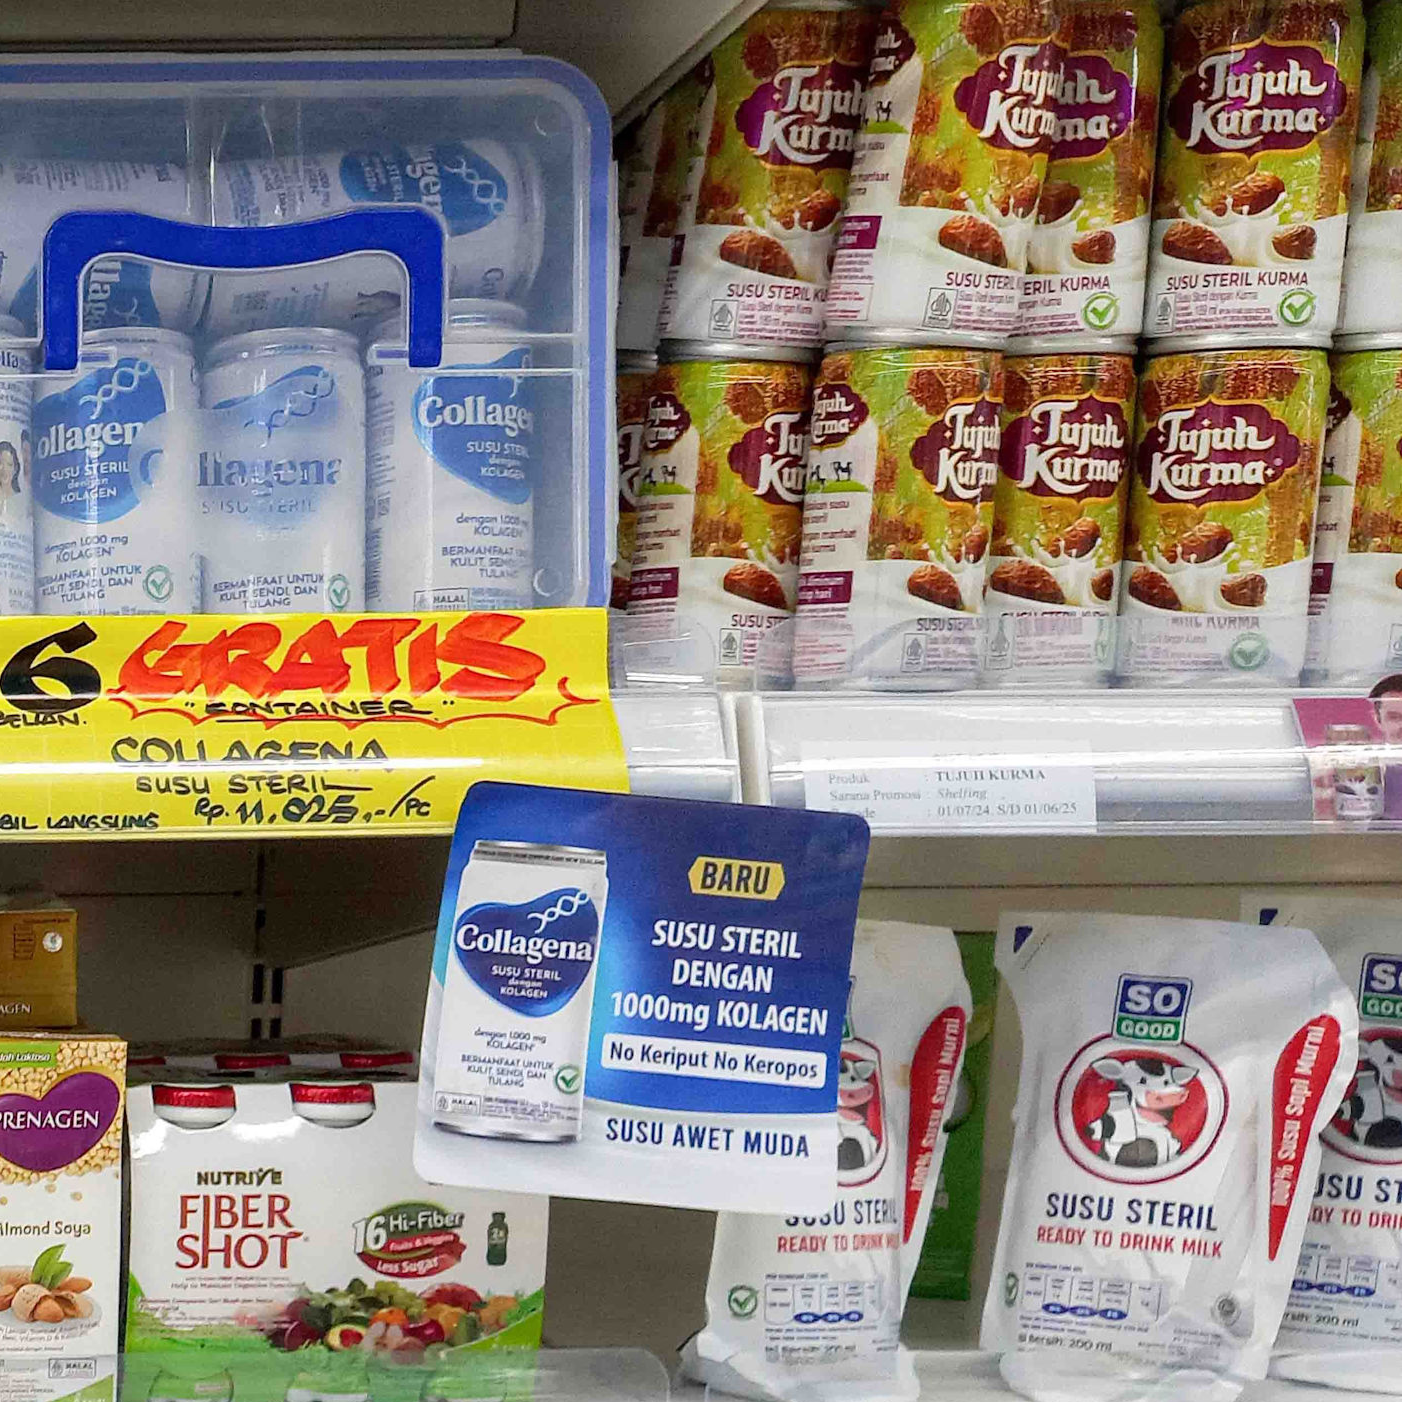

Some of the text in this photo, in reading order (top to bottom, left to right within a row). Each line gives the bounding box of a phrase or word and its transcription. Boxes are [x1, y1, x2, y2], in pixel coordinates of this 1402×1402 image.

[1198, 50, 1326, 105] Tujuh
[1186, 103, 1319, 149] Kurma
[1166, 271, 1309, 290] SUSU STERIL KURMA
[0, 622, 102, 714] 6
[137, 775, 374, 795] SUSU STERIL
[699, 861, 770, 895] BARU
[456, 922, 592, 965] Collagena
[652, 920, 802, 959] SUSU STERIL
[672, 958, 774, 992] DENGAN
[611, 991, 828, 1037] 1000mg KOLAGEN
[1125, 985, 1182, 1016] SO
[1120, 1018, 1177, 1038] GOOD
[609, 1044, 820, 1081] No Keriput No Keropos
[605, 1117, 809, 1158] SUSU AWET MUDA
[55, 1221, 91, 1240] Soya
[179, 1194, 289, 1230] FIBER
[1045, 1192, 1218, 1232] SUSU STERIL
[175, 1231, 306, 1270] SHOT
[1037, 1225, 1224, 1258] READY TO DRINK MILK
